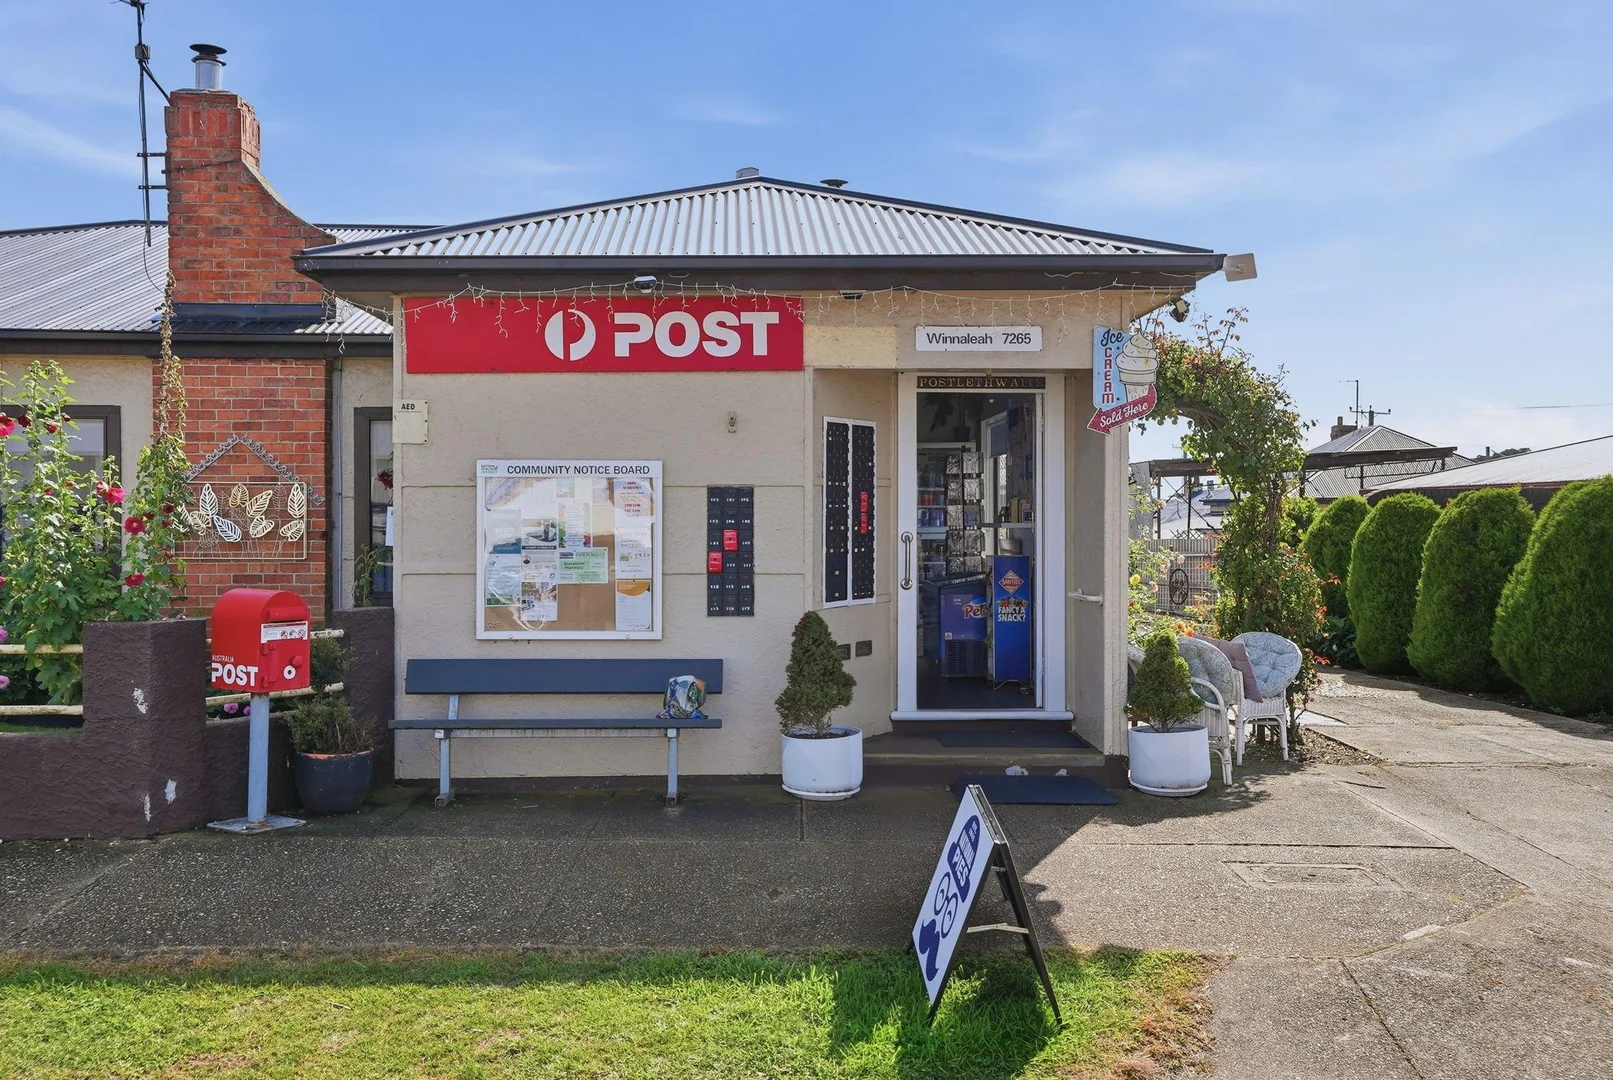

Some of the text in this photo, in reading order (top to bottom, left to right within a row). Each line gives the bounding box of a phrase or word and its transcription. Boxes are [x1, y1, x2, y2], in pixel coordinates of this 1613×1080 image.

[613, 310, 780, 358] POST
[926, 332, 1032, 345] Winnaleah 7265
[1100, 328, 1125, 347] Ice
[1102, 347, 1115, 404] CREAM
[1100, 402, 1149, 428] Sold Here
[507, 465, 571, 475] COMMUNITY
[573, 465, 611, 475] NOTICE
[613, 465, 650, 475] BOARD
[997, 613, 1026, 622] SNACK?
[998, 606, 1026, 614] FANCY A
[212, 654, 235, 663] AUSTRALIA
[211, 662, 259, 687] POST
